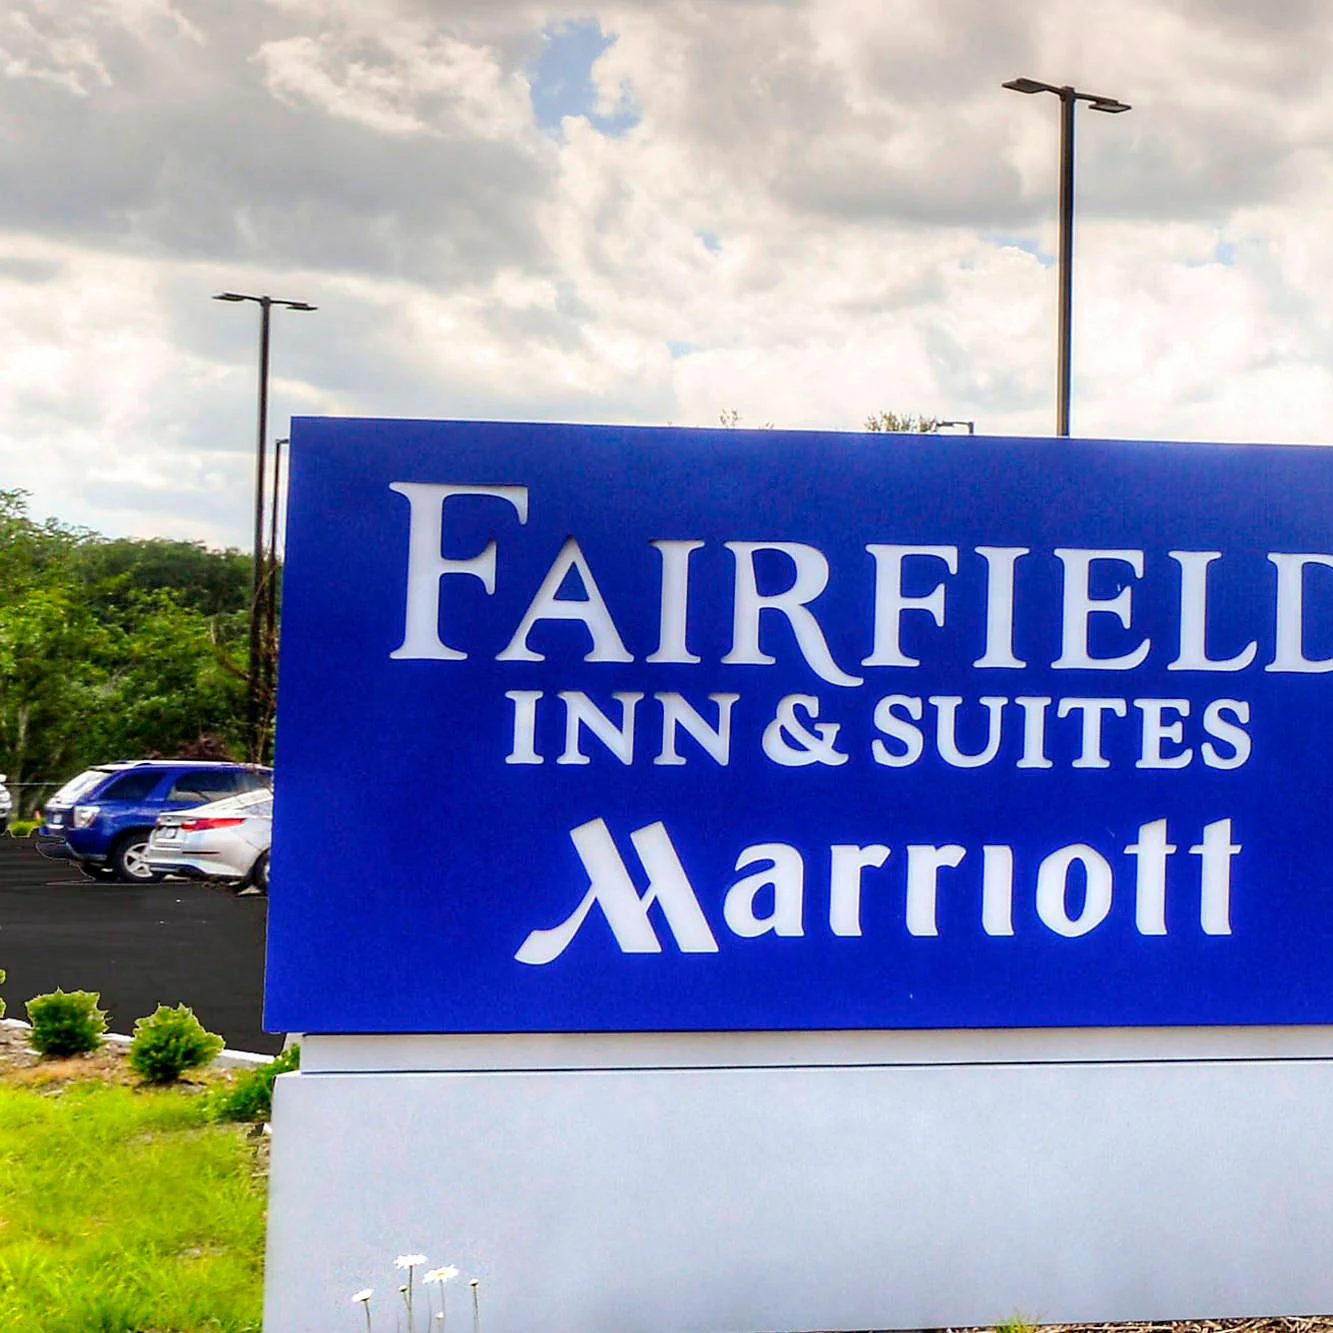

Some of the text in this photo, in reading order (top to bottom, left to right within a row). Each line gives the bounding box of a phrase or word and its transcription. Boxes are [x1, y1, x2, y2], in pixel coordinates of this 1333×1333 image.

[504, 689, 1252, 771] INN & SUITES
[513, 817, 1243, 966] Marriott
